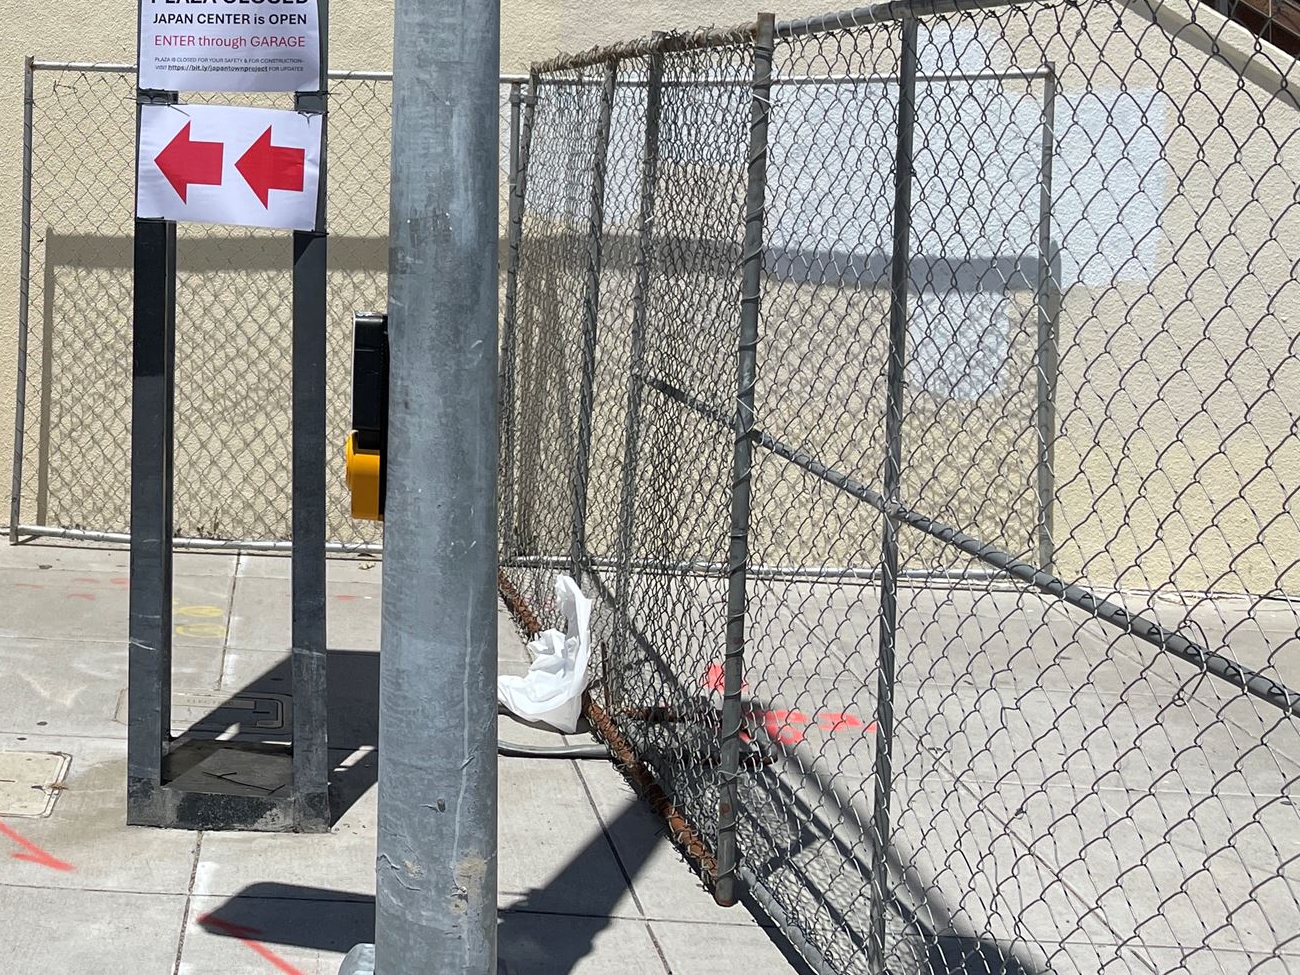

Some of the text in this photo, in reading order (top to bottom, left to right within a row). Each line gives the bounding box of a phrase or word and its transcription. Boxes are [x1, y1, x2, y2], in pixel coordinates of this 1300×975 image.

[153, 13, 307, 25] JAPAN CENTER is OPEN
[155, 35, 305, 49] ENTER through GARAGE
